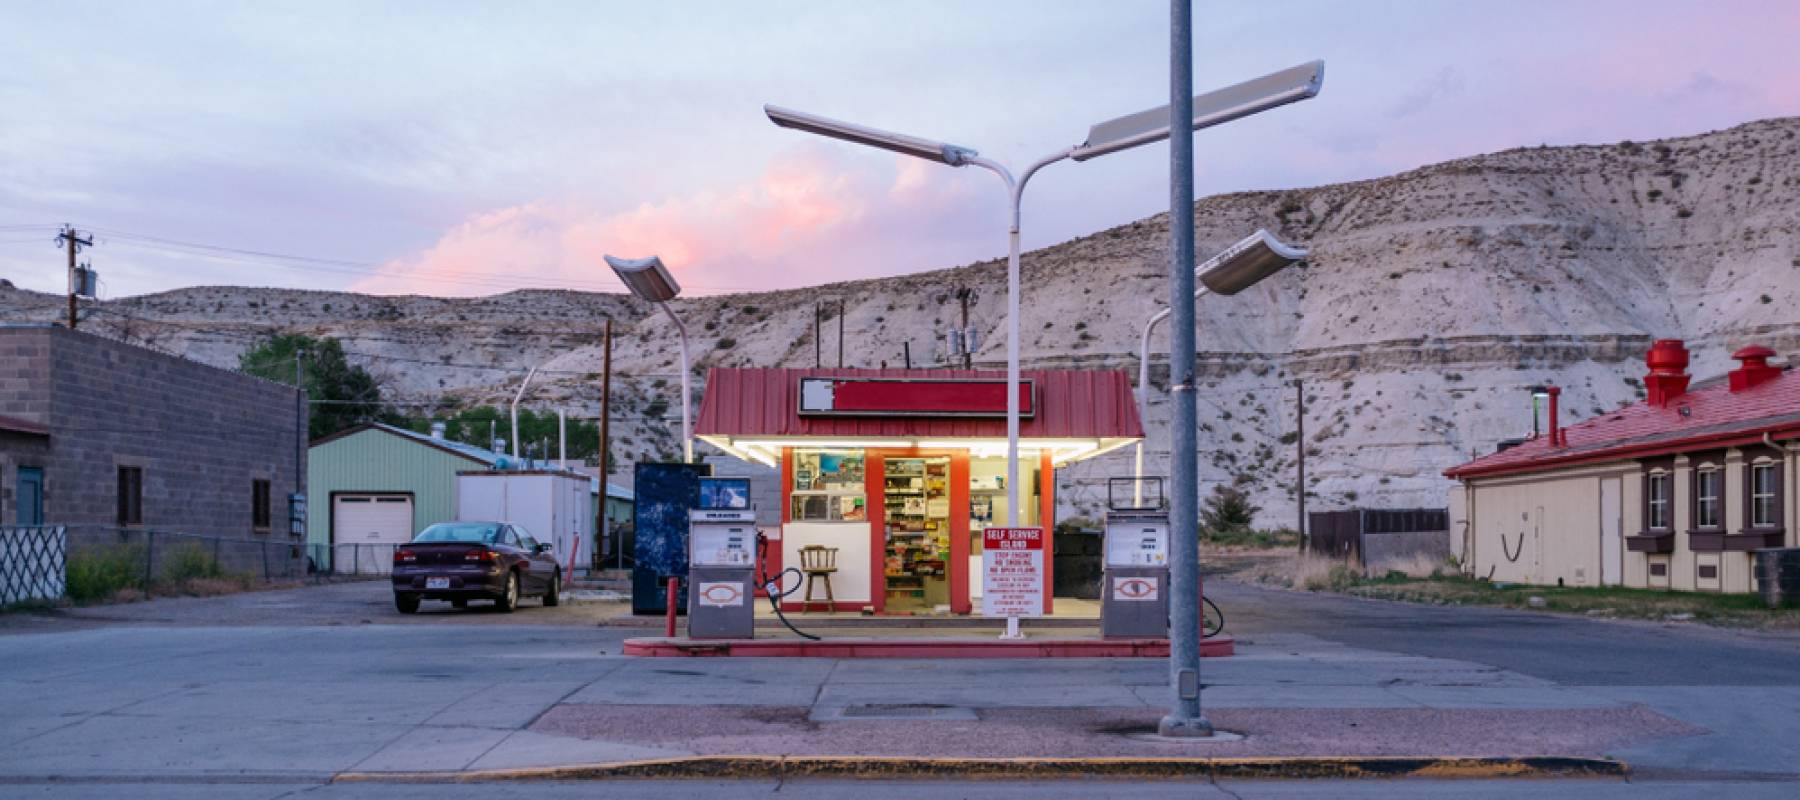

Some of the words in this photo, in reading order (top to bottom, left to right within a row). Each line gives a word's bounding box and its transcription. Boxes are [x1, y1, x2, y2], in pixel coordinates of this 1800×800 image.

[987, 530, 1006, 540] SELF
[1009, 530, 1040, 540] SERVICE
[1000, 541, 1027, 549] ISLAND
